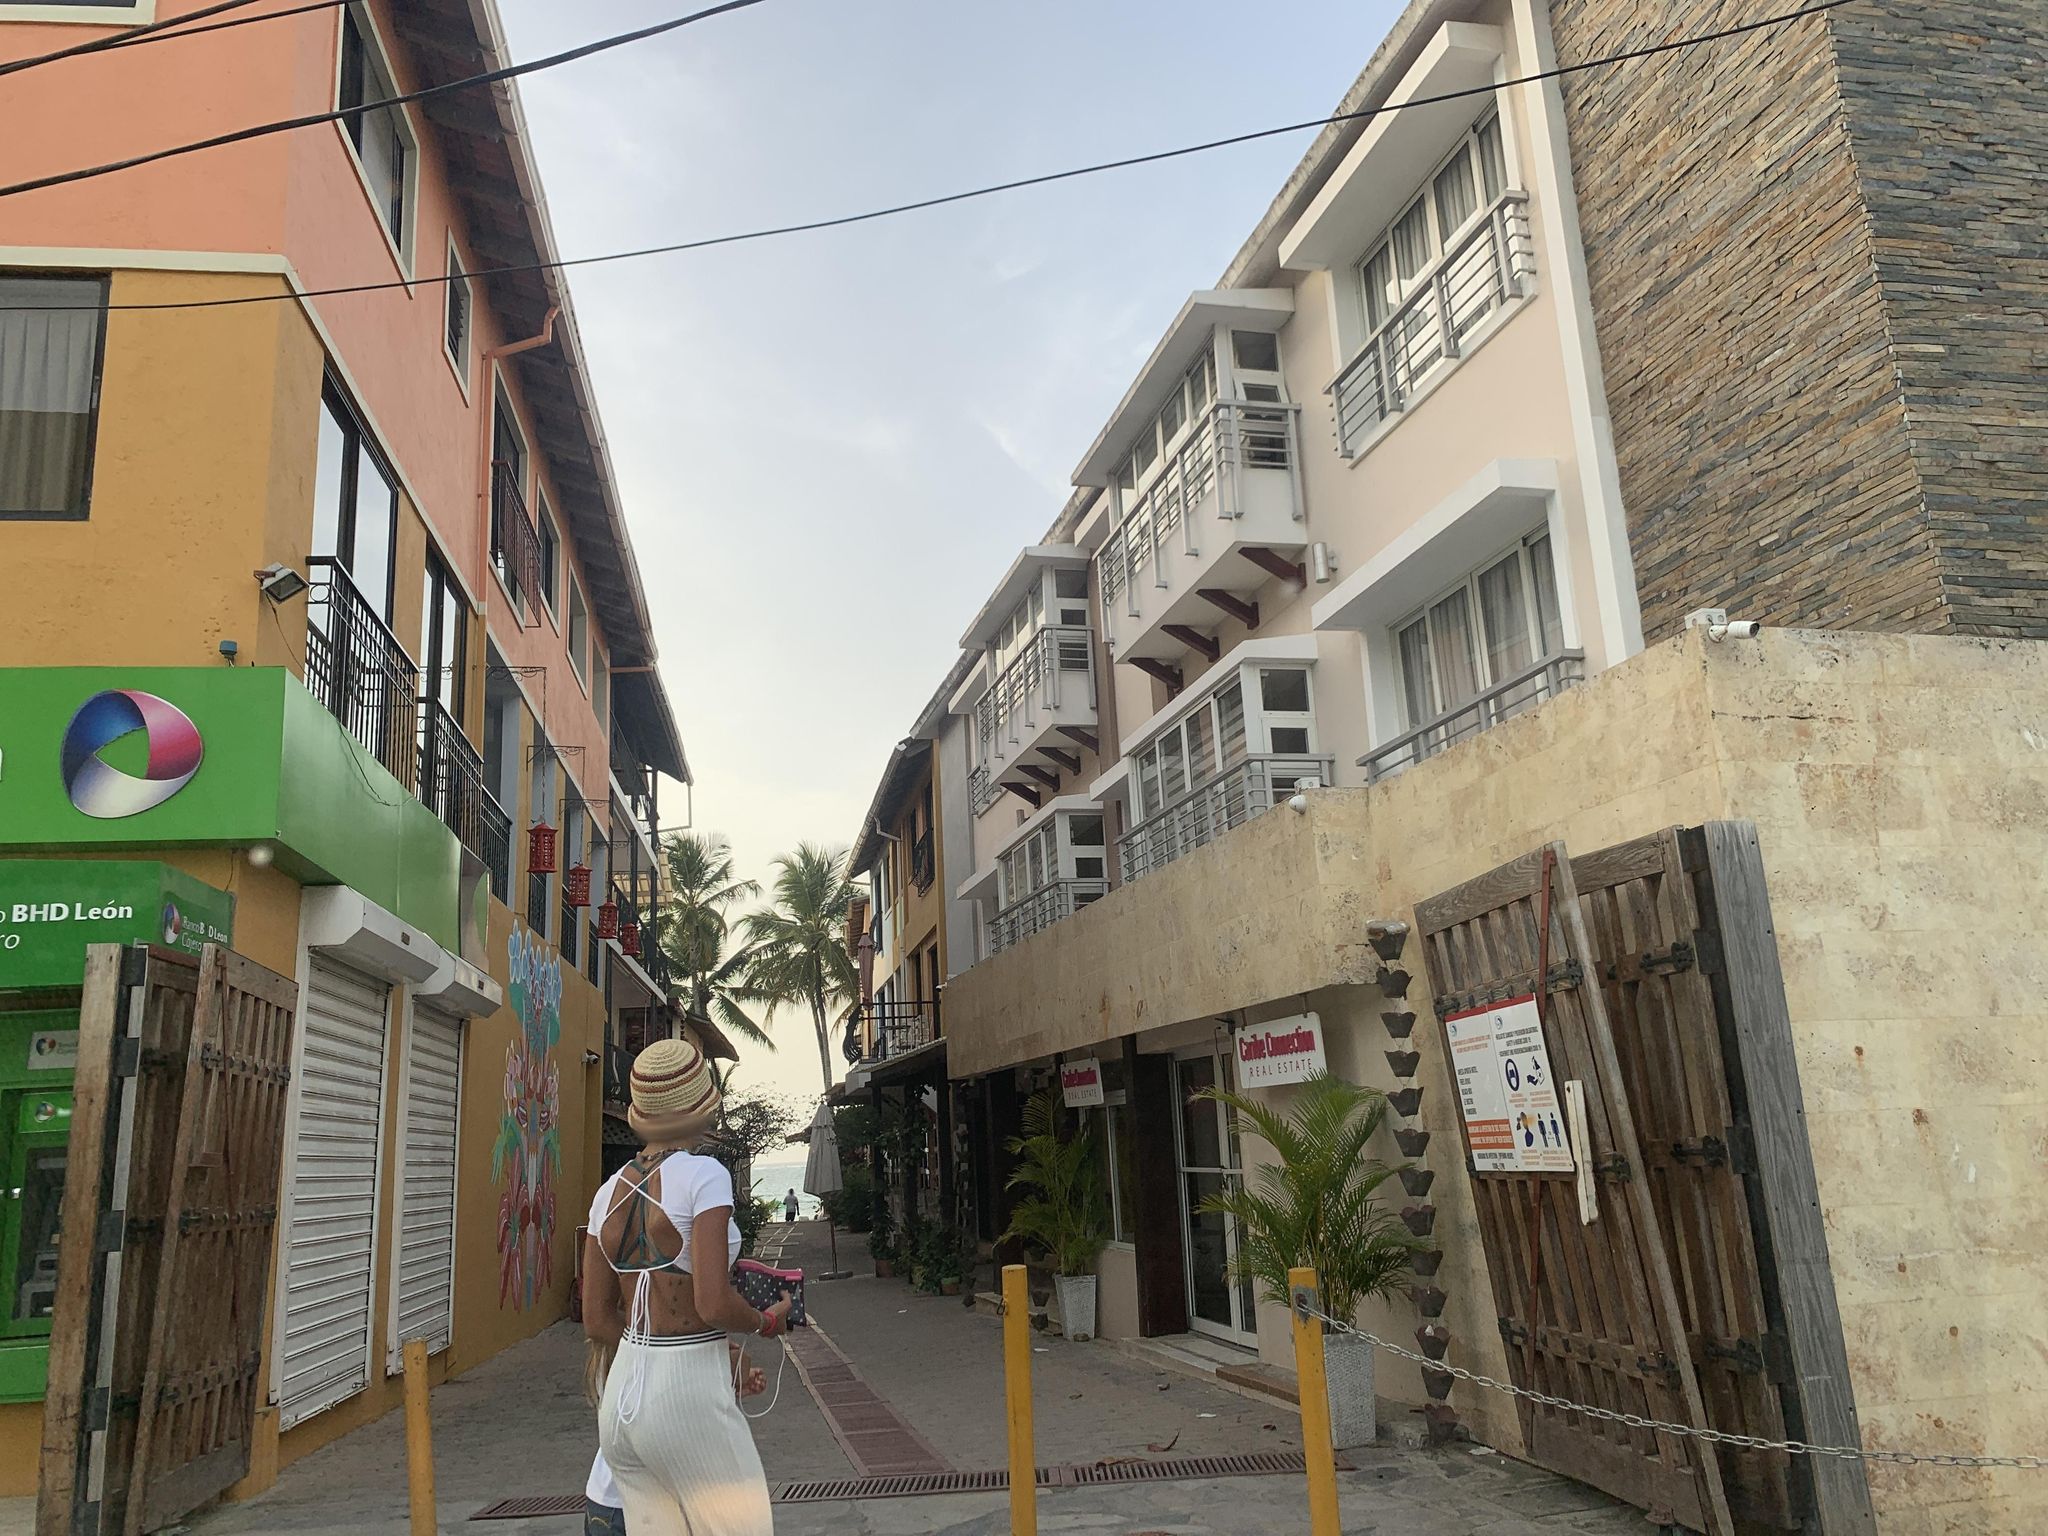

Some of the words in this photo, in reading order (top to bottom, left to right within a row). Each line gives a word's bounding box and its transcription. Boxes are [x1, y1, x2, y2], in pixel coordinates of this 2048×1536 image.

[12, 903, 69, 923] BHD
[75, 900, 133, 921] León
[1249, 1065, 1273, 1078] REAL
[1277, 1058, 1312, 1074] ESTATE
